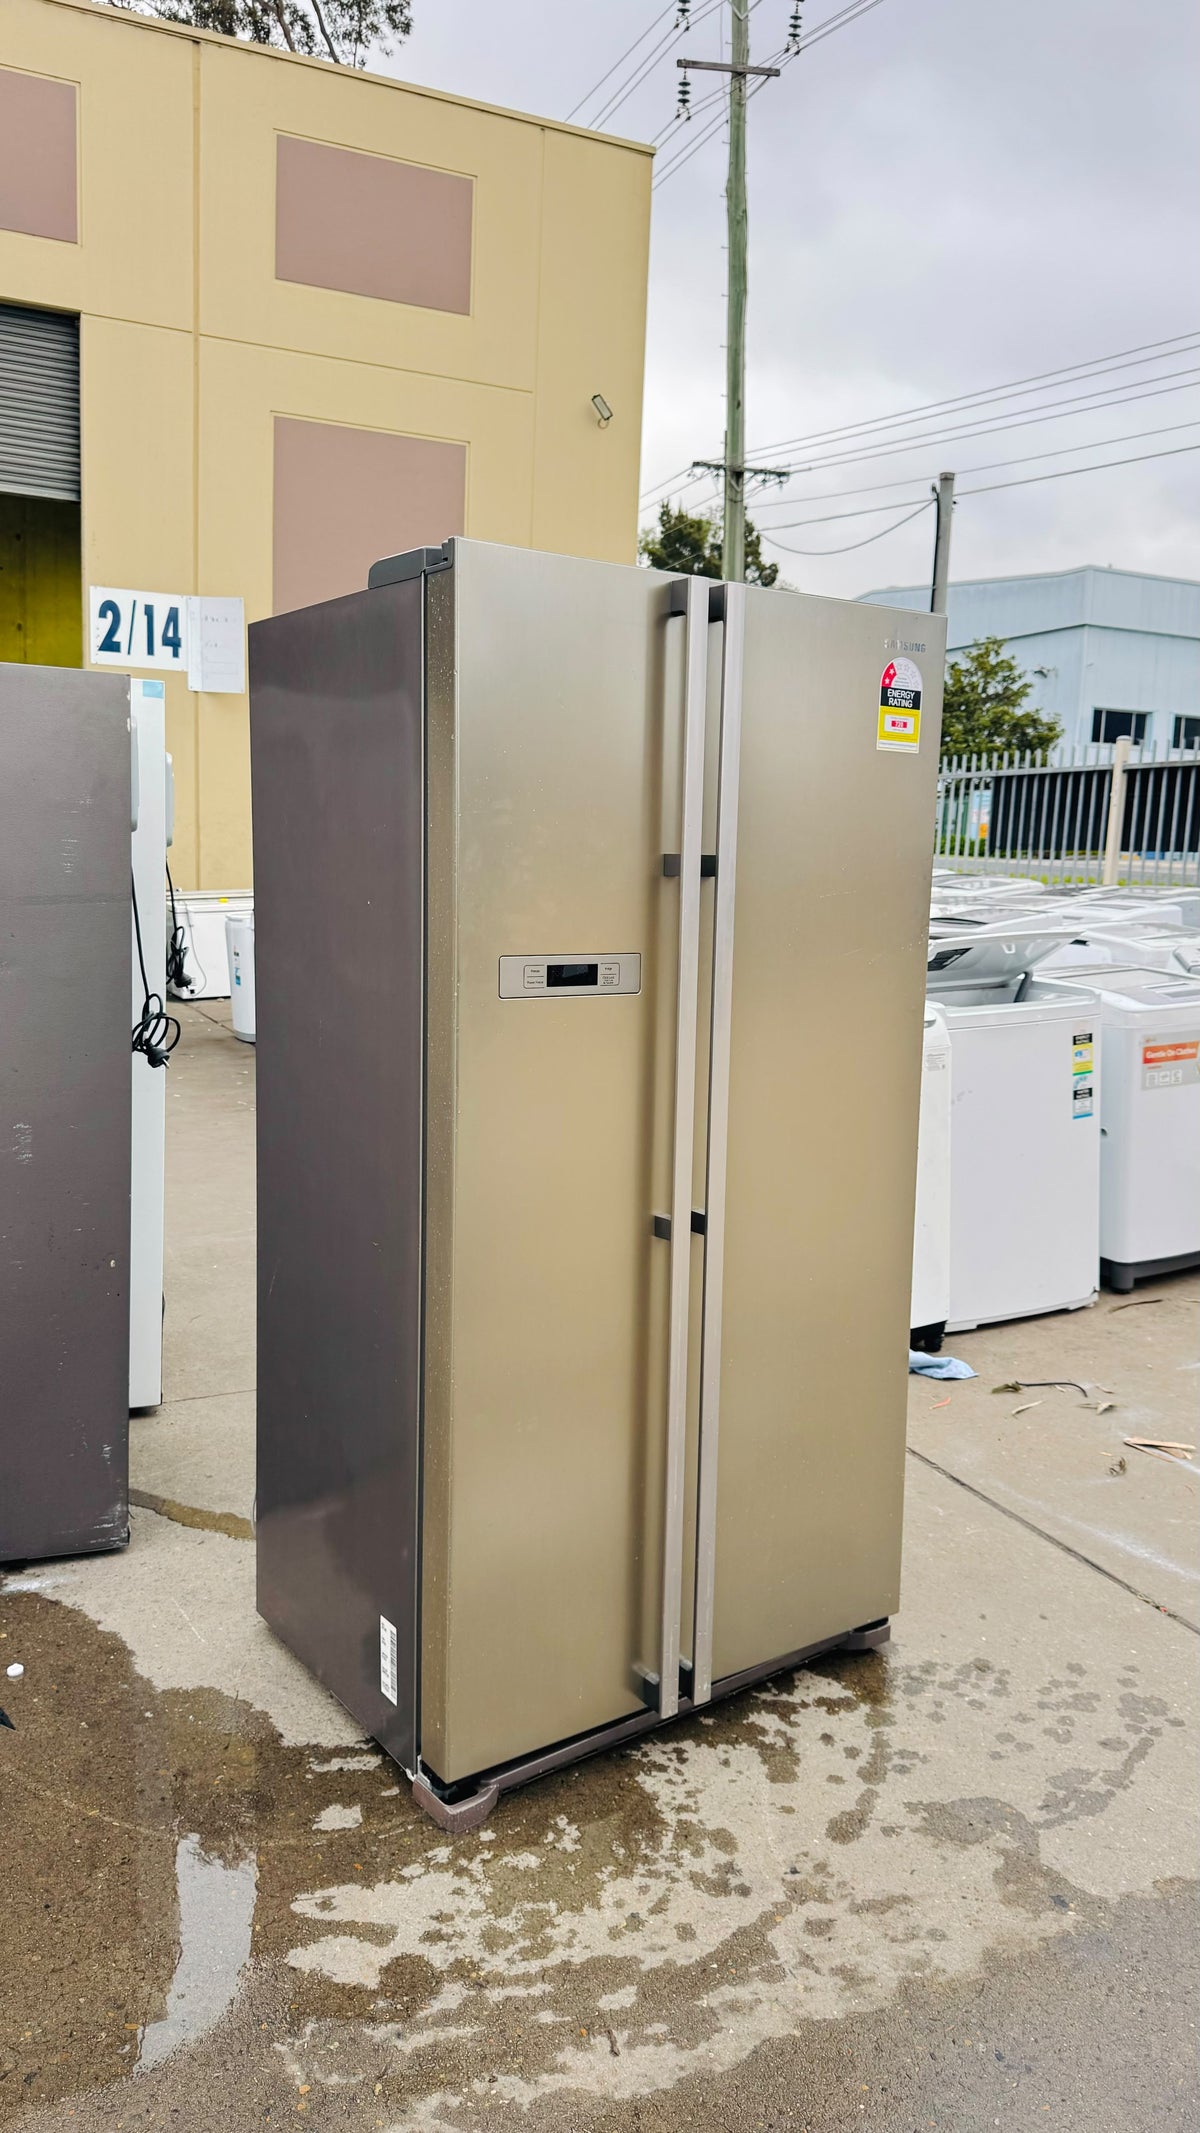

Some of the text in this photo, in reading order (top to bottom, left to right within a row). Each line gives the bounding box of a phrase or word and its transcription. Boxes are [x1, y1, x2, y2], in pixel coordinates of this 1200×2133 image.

[98, 599, 182, 659] 2/14
[887, 688, 915, 699] ENERGY
[888, 697, 913, 708] RATING
